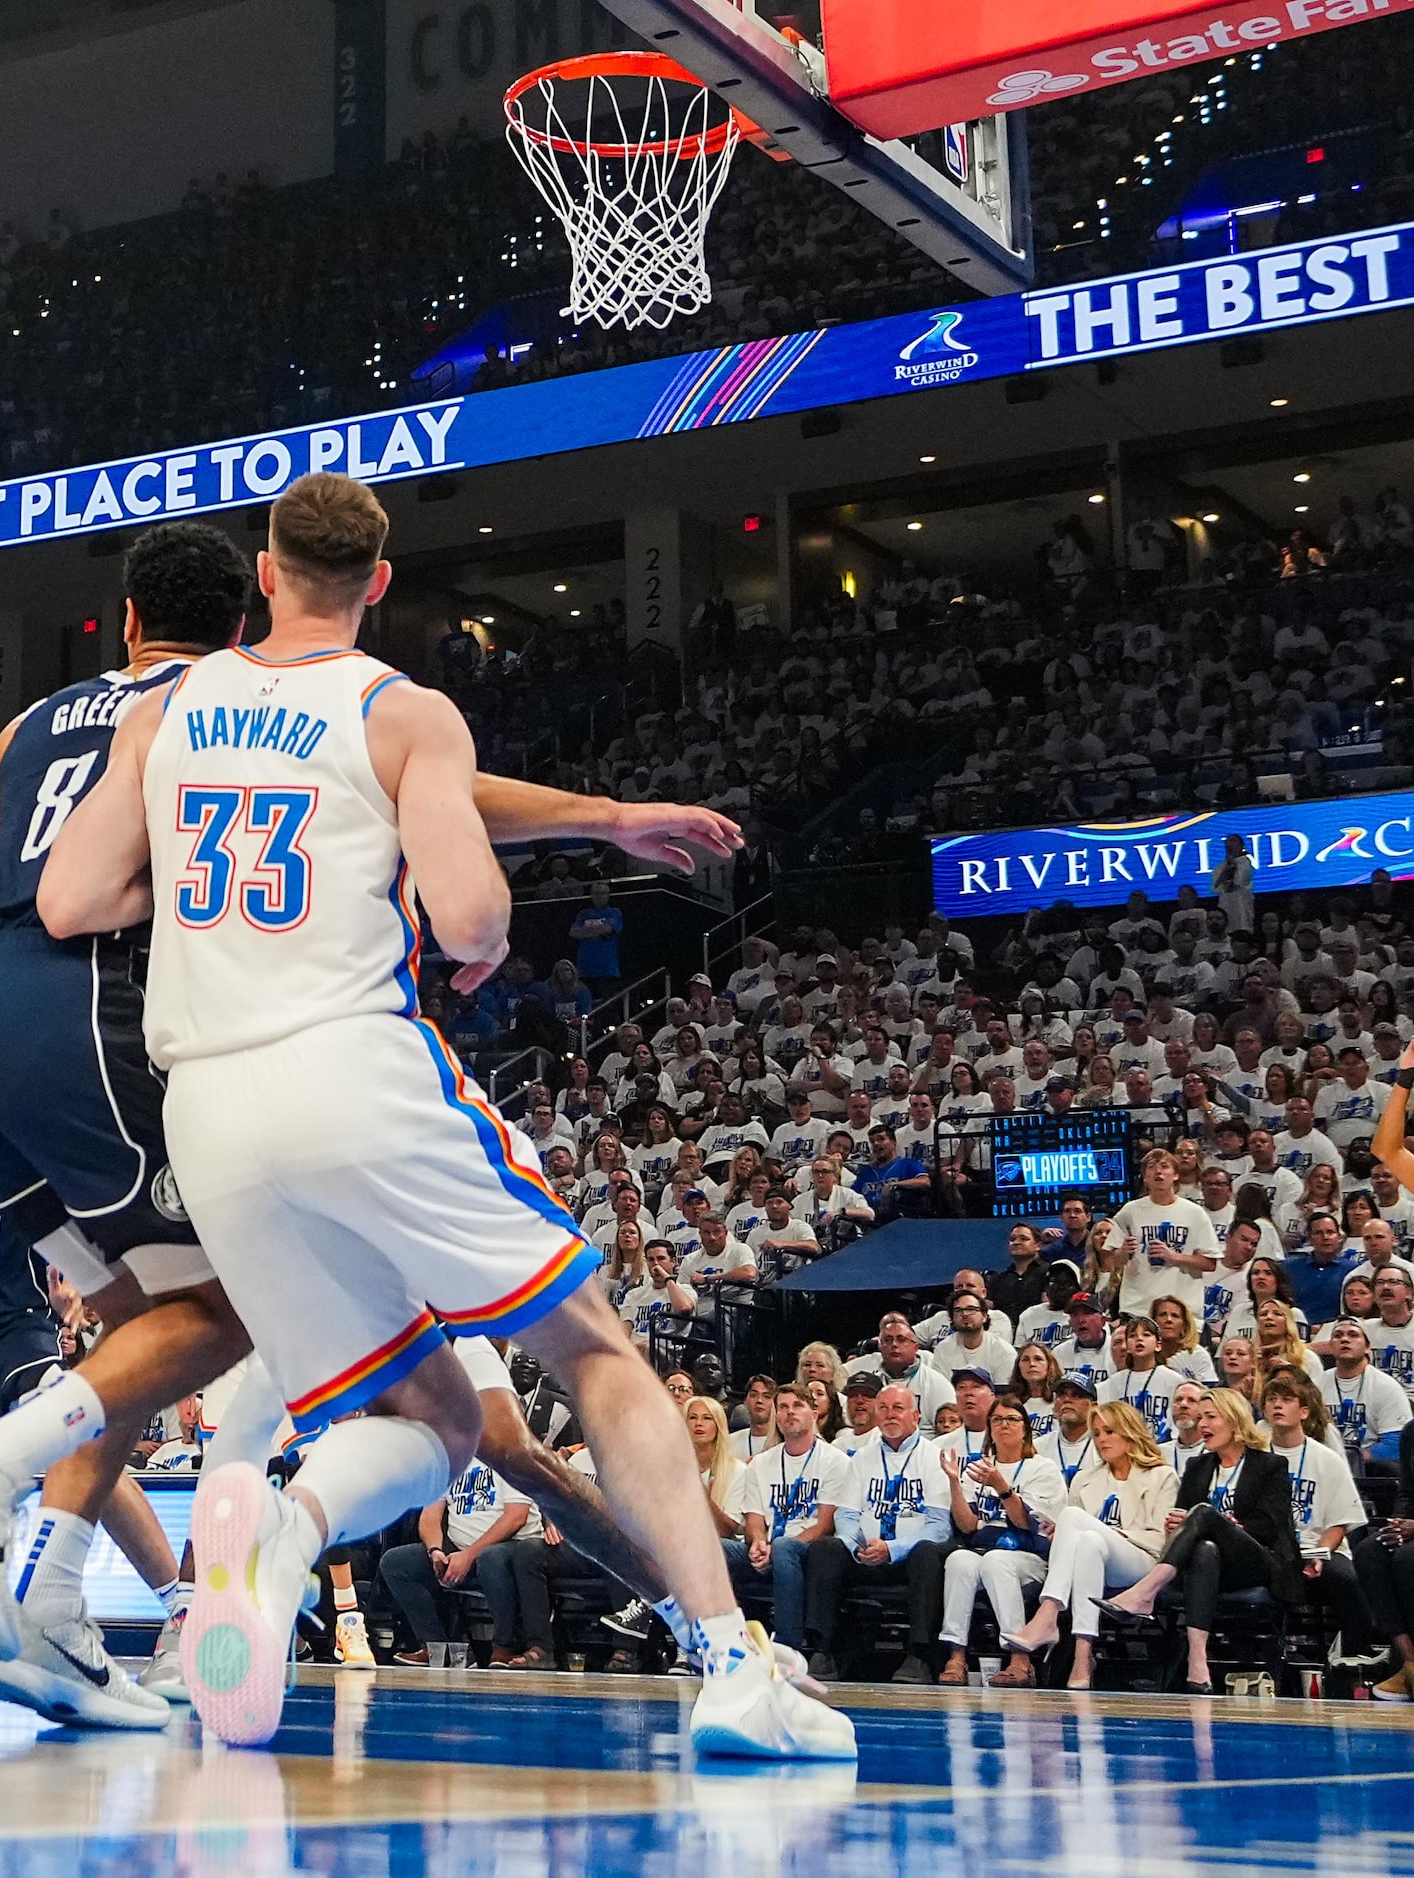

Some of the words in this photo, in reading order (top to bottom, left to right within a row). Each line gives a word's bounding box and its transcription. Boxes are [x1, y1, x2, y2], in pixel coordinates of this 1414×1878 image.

[1090, 16, 1283, 79] State
[1027, 275, 1184, 359] THE
[1204, 235, 1400, 331] BEST
[894, 353, 979, 379] RIVERWIND
[911, 370, 960, 386] CASINO
[20, 459, 196, 536] PLACE
[210, 440, 292, 497] TO
[308, 406, 461, 477] PLAY
[645, 548, 660, 628] 222
[186, 706, 327, 760] HAYWARD
[20, 751, 99, 863] 8
[174, 784, 319, 933] 33
[1022, 1153, 1098, 1184] PLAYOFFS
